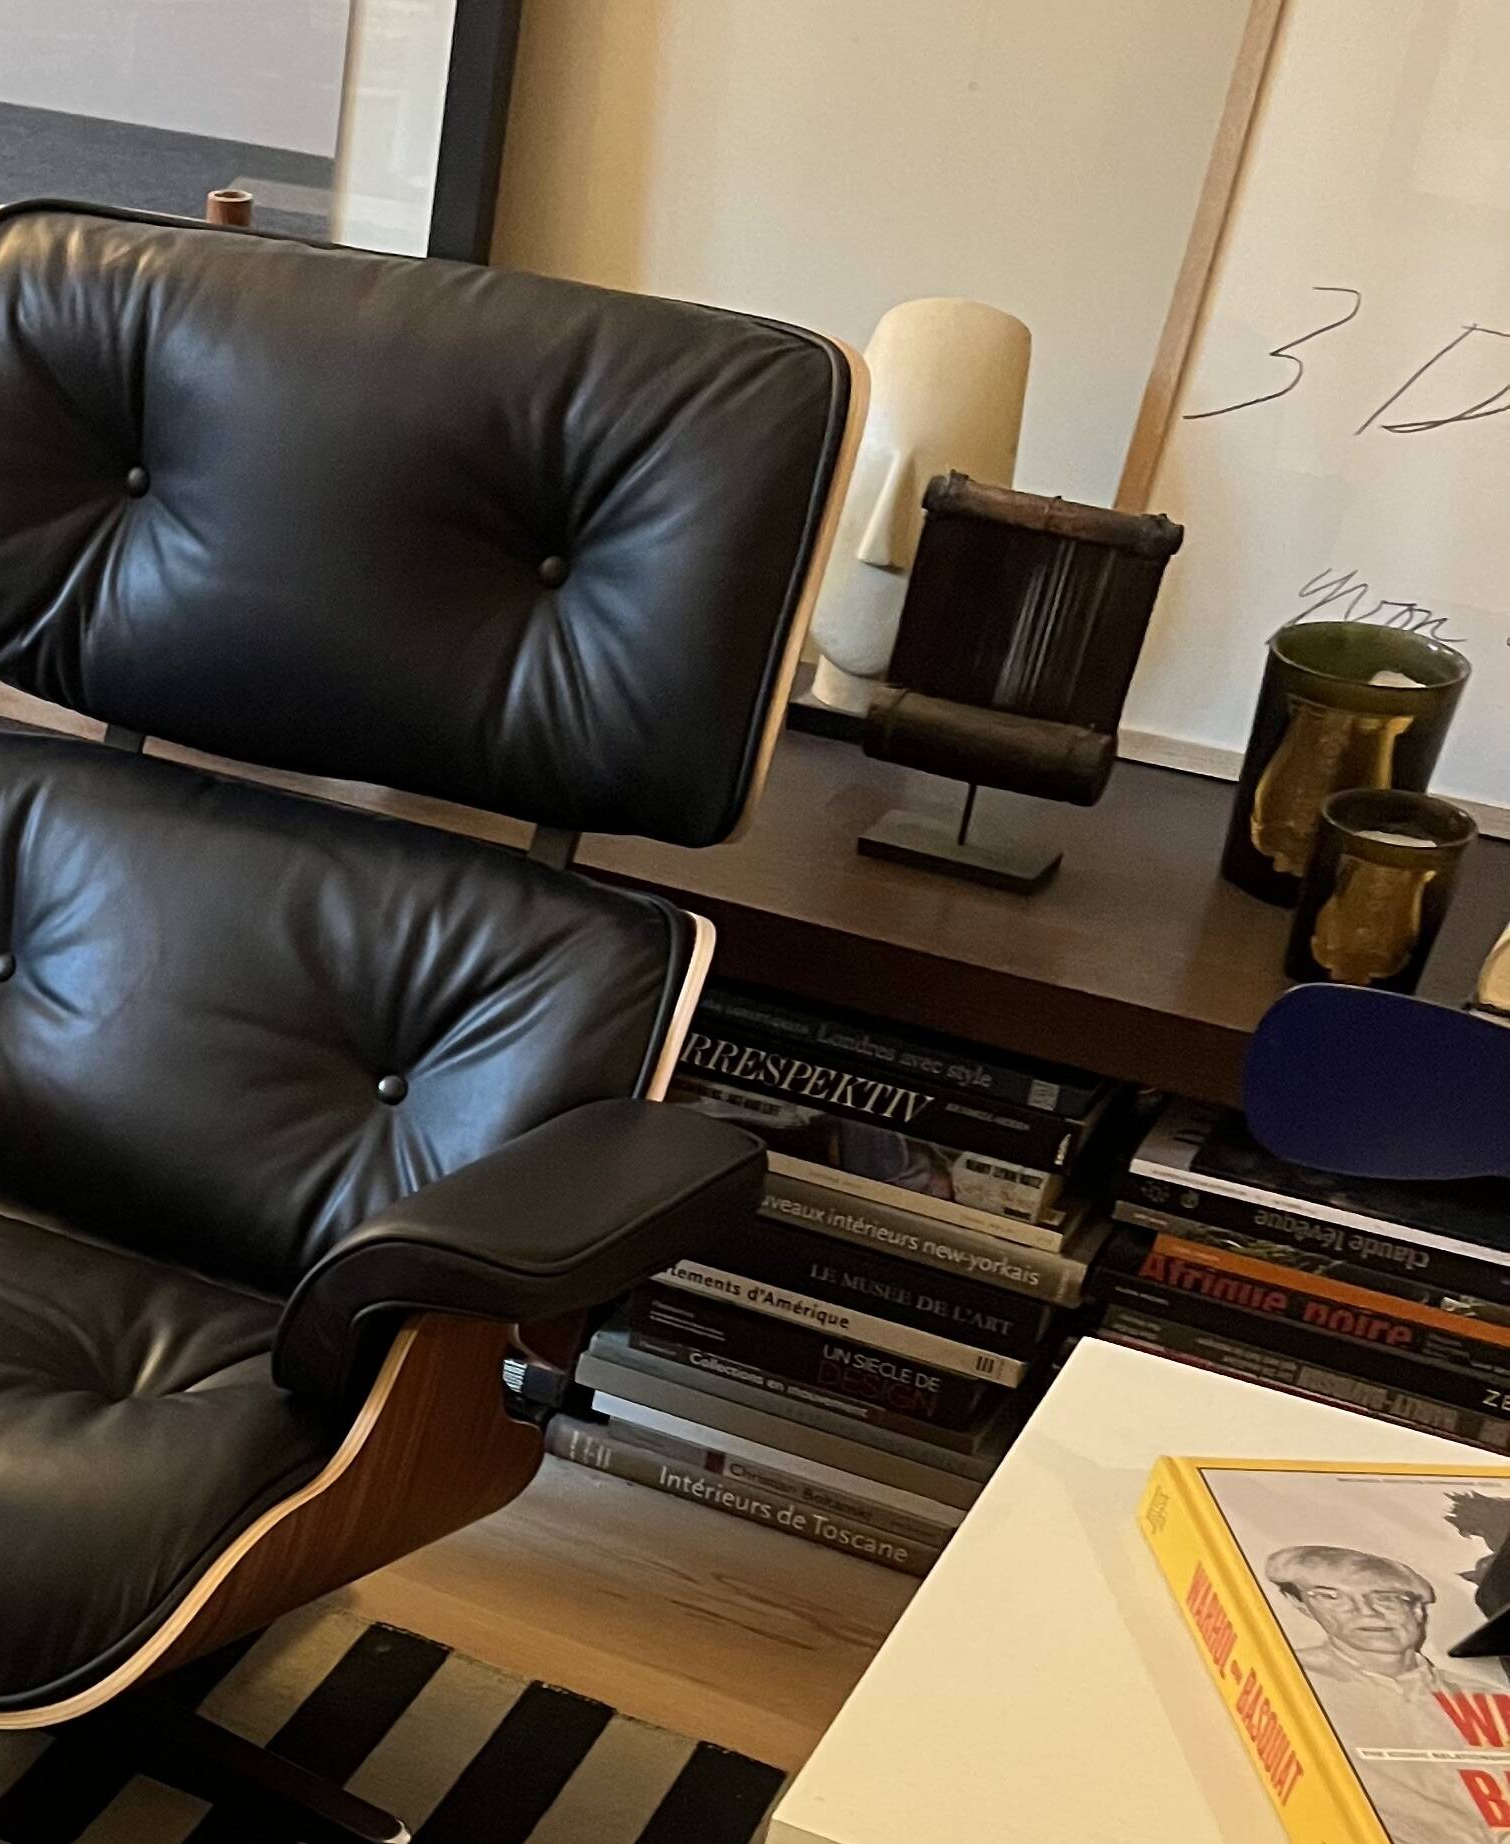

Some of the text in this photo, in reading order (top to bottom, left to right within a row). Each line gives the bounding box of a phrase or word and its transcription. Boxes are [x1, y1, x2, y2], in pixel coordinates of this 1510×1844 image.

[945, 1062, 993, 1088] style
[827, 1208, 919, 1251] intérieurs
[921, 1242, 1041, 1286] new-yorkais
[1349, 1234, 1431, 1271] claude
[746, 1285, 851, 1330] d'Amérique
[810, 1262, 837, 1284] LE
[915, 1294, 948, 1318] DE
[1302, 1301, 1414, 1345] noire
[689, 1351, 765, 1386] Collections
[765, 1378, 786, 1393] en
[822, 1342, 851, 1365] UN
[914, 1372, 942, 1393] DE
[658, 1465, 910, 1564] Intérieurs de Toscane
